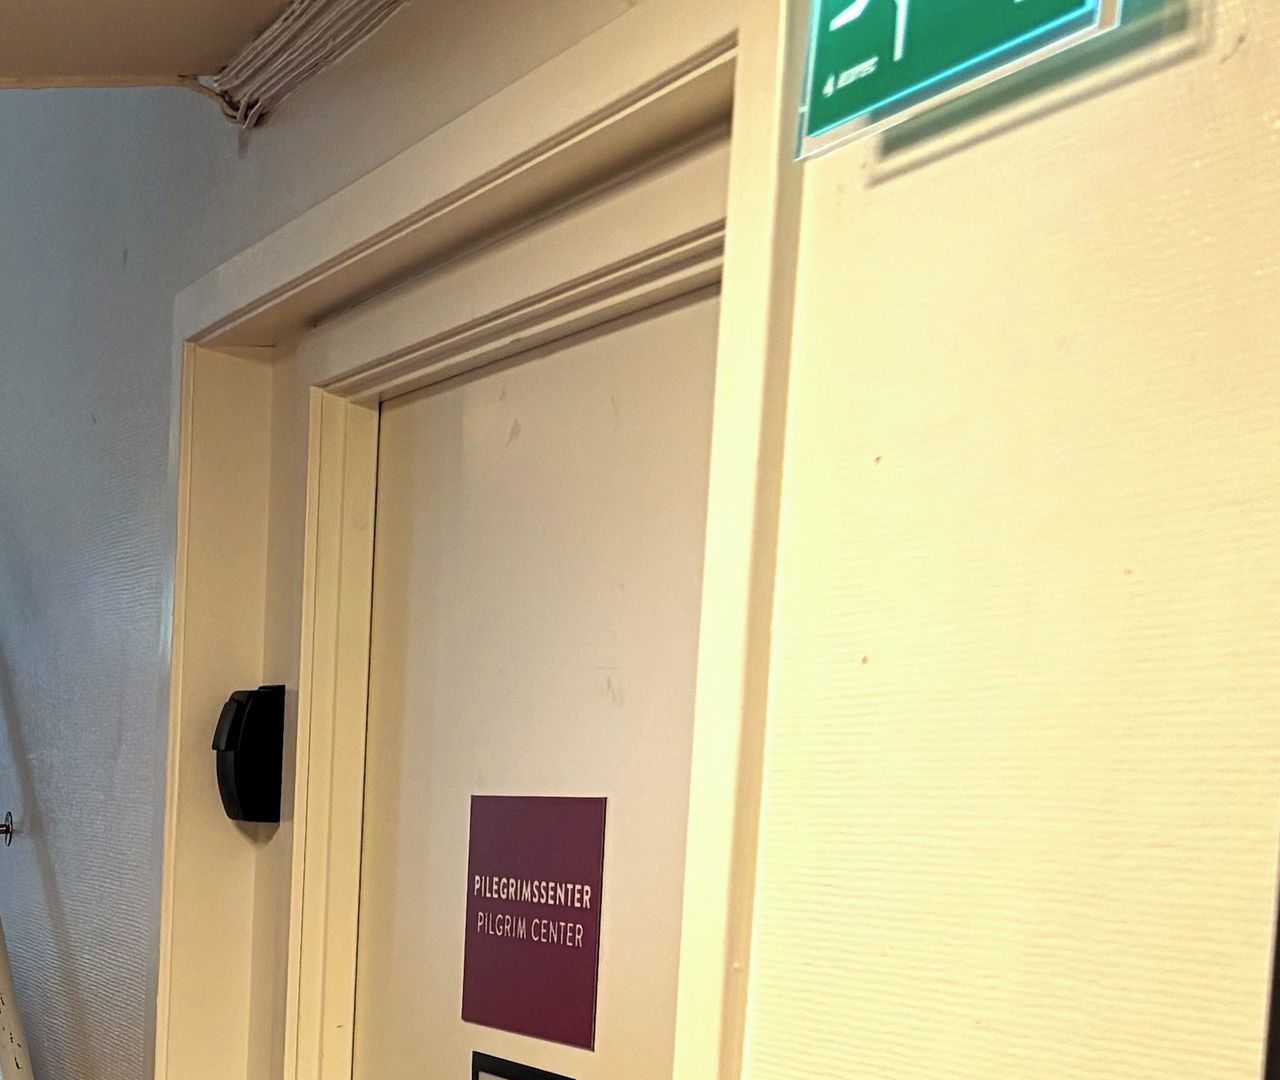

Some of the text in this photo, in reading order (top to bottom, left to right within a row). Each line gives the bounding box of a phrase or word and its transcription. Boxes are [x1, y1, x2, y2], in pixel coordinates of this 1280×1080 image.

[474, 875, 592, 909] PILEGRIMSSENTER
[477, 911, 584, 948] PILGRIM CENTER
